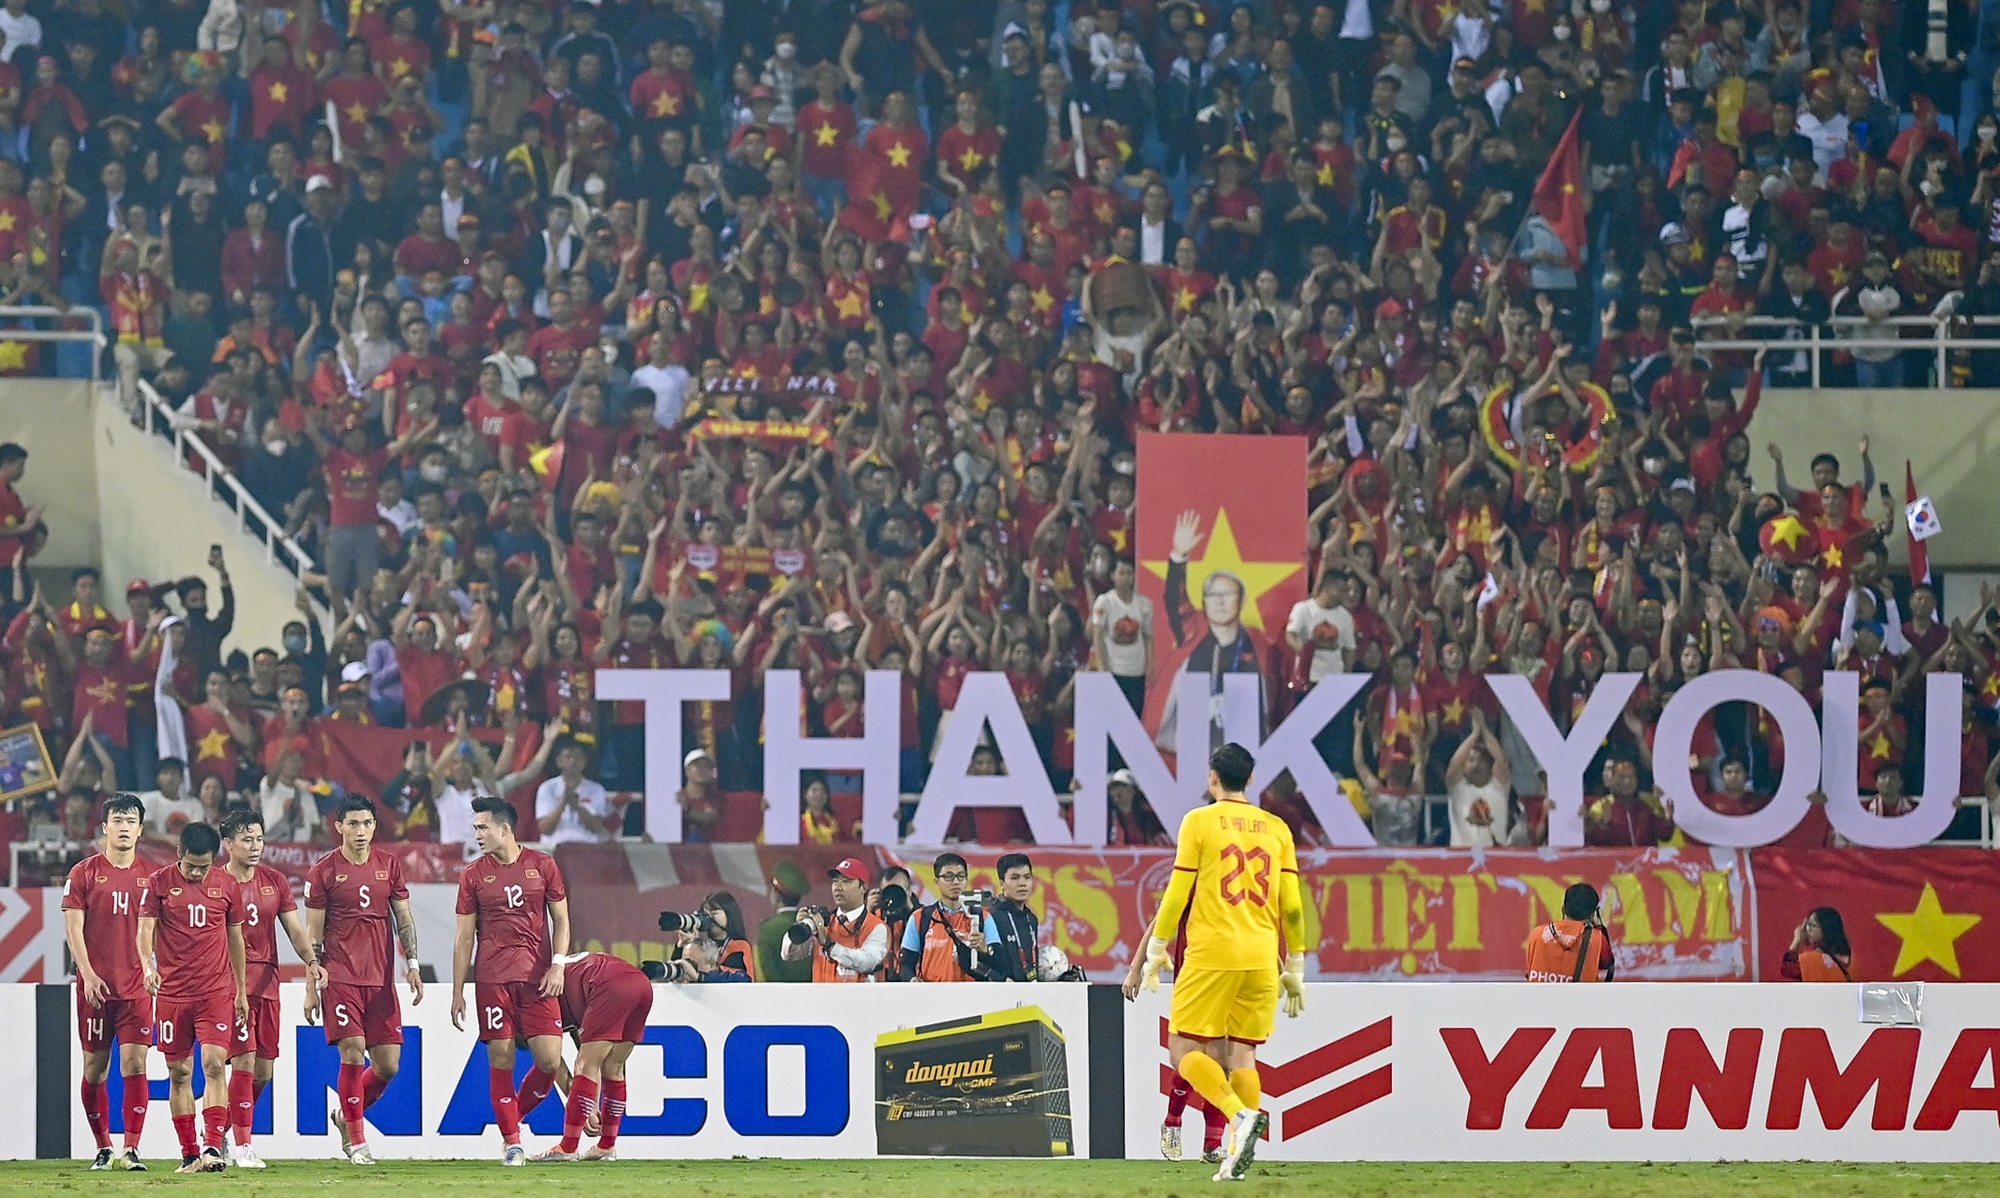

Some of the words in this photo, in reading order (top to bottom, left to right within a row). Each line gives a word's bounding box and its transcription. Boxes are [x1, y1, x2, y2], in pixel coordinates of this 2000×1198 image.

[594, 669, 1378, 847] THANK
[1486, 668, 1964, 849] YOU
[1220, 843, 1271, 907] 23
[111, 890, 129, 915] 14
[503, 884, 525, 909] 12
[187, 903, 207, 928] 10
[246, 903, 259, 926] 3
[86, 1017, 104, 1041] 14
[235, 1018, 249, 1042] 3
[485, 1006, 504, 1030] 12
[159, 1019, 174, 1044] 10
[905, 1054, 994, 1086] dongnai
[970, 1077, 998, 1088] CMF
[1439, 1027, 2000, 1131] YANMA
